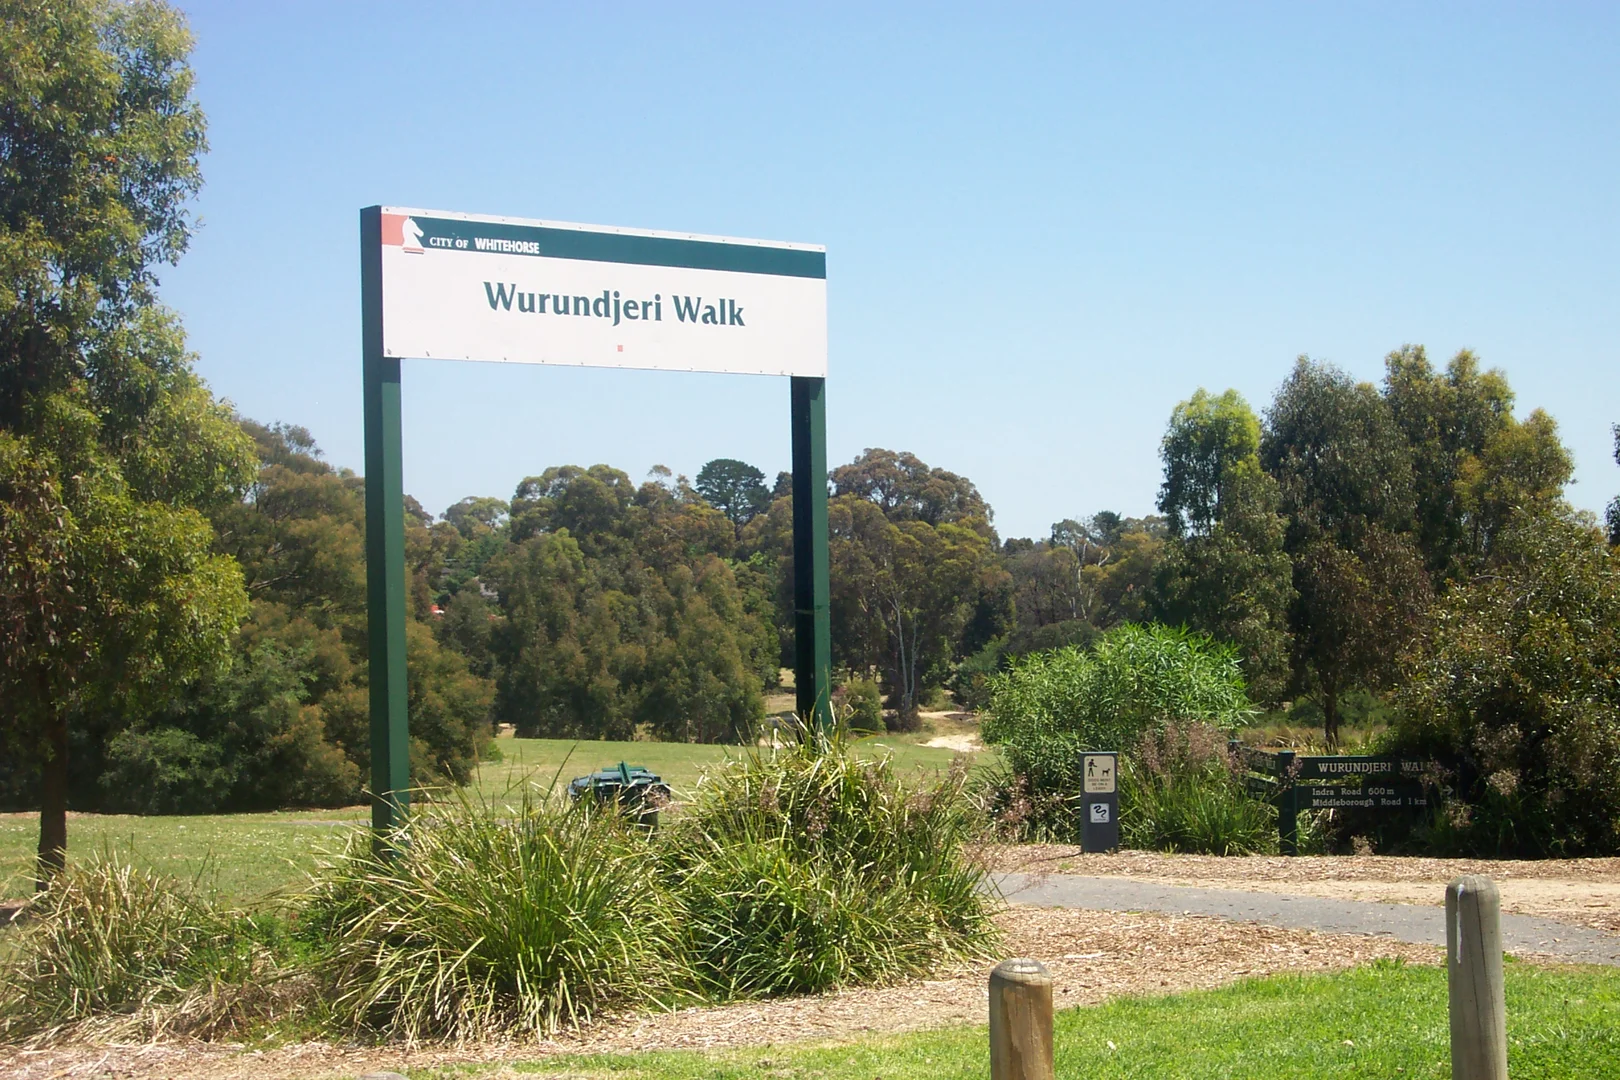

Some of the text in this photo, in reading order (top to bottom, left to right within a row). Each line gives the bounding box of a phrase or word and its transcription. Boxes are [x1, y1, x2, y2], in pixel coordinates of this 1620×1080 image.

[429, 236, 540, 255] CITY OF WHITEHORSE
[483, 281, 746, 327] Wurundjeri Walk
[1318, 762, 1392, 774] WURUNDJERI
[1312, 788, 1334, 796] Indra
[1341, 787, 1362, 796] Road
[1312, 798, 1375, 808] Middleborough
[1381, 797, 1402, 806] Road
